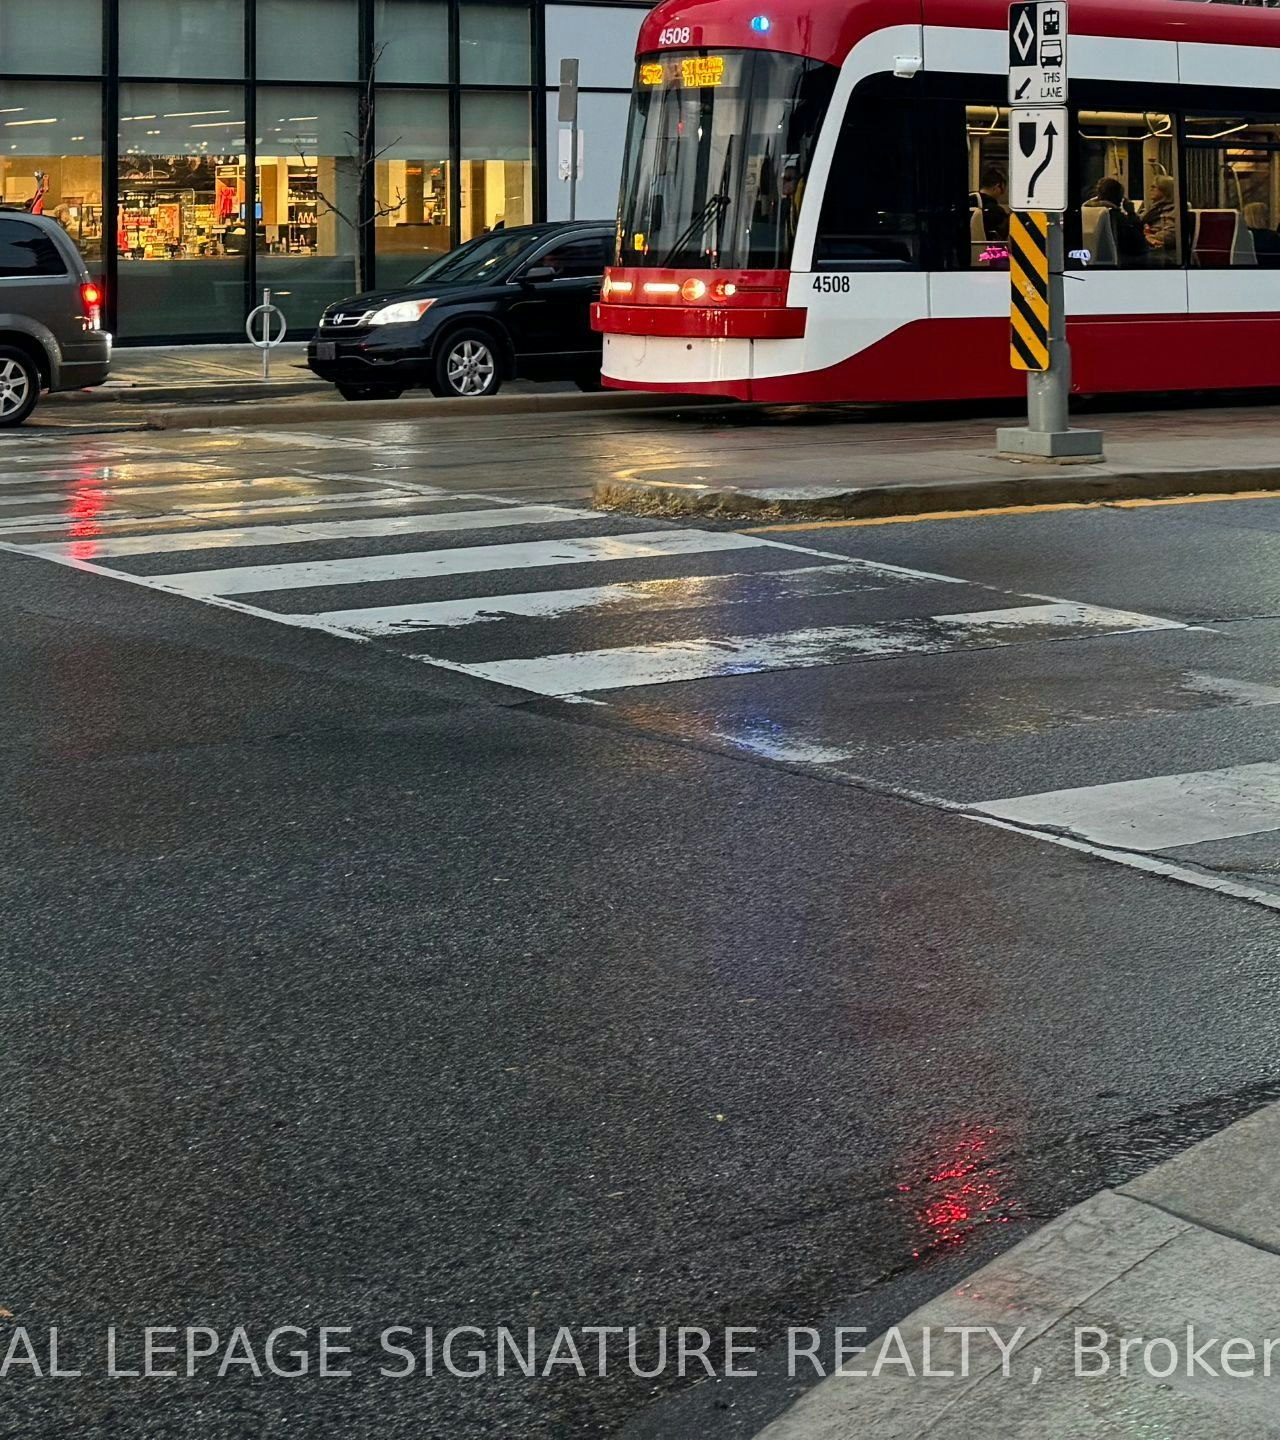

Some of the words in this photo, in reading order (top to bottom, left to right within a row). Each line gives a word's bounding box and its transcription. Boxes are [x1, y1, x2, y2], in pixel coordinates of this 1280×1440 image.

[659, 27, 690, 45] 4508
[1043, 72, 1061, 83] THIS
[1040, 87, 1063, 98] LANE
[812, 275, 850, 293] 4508
